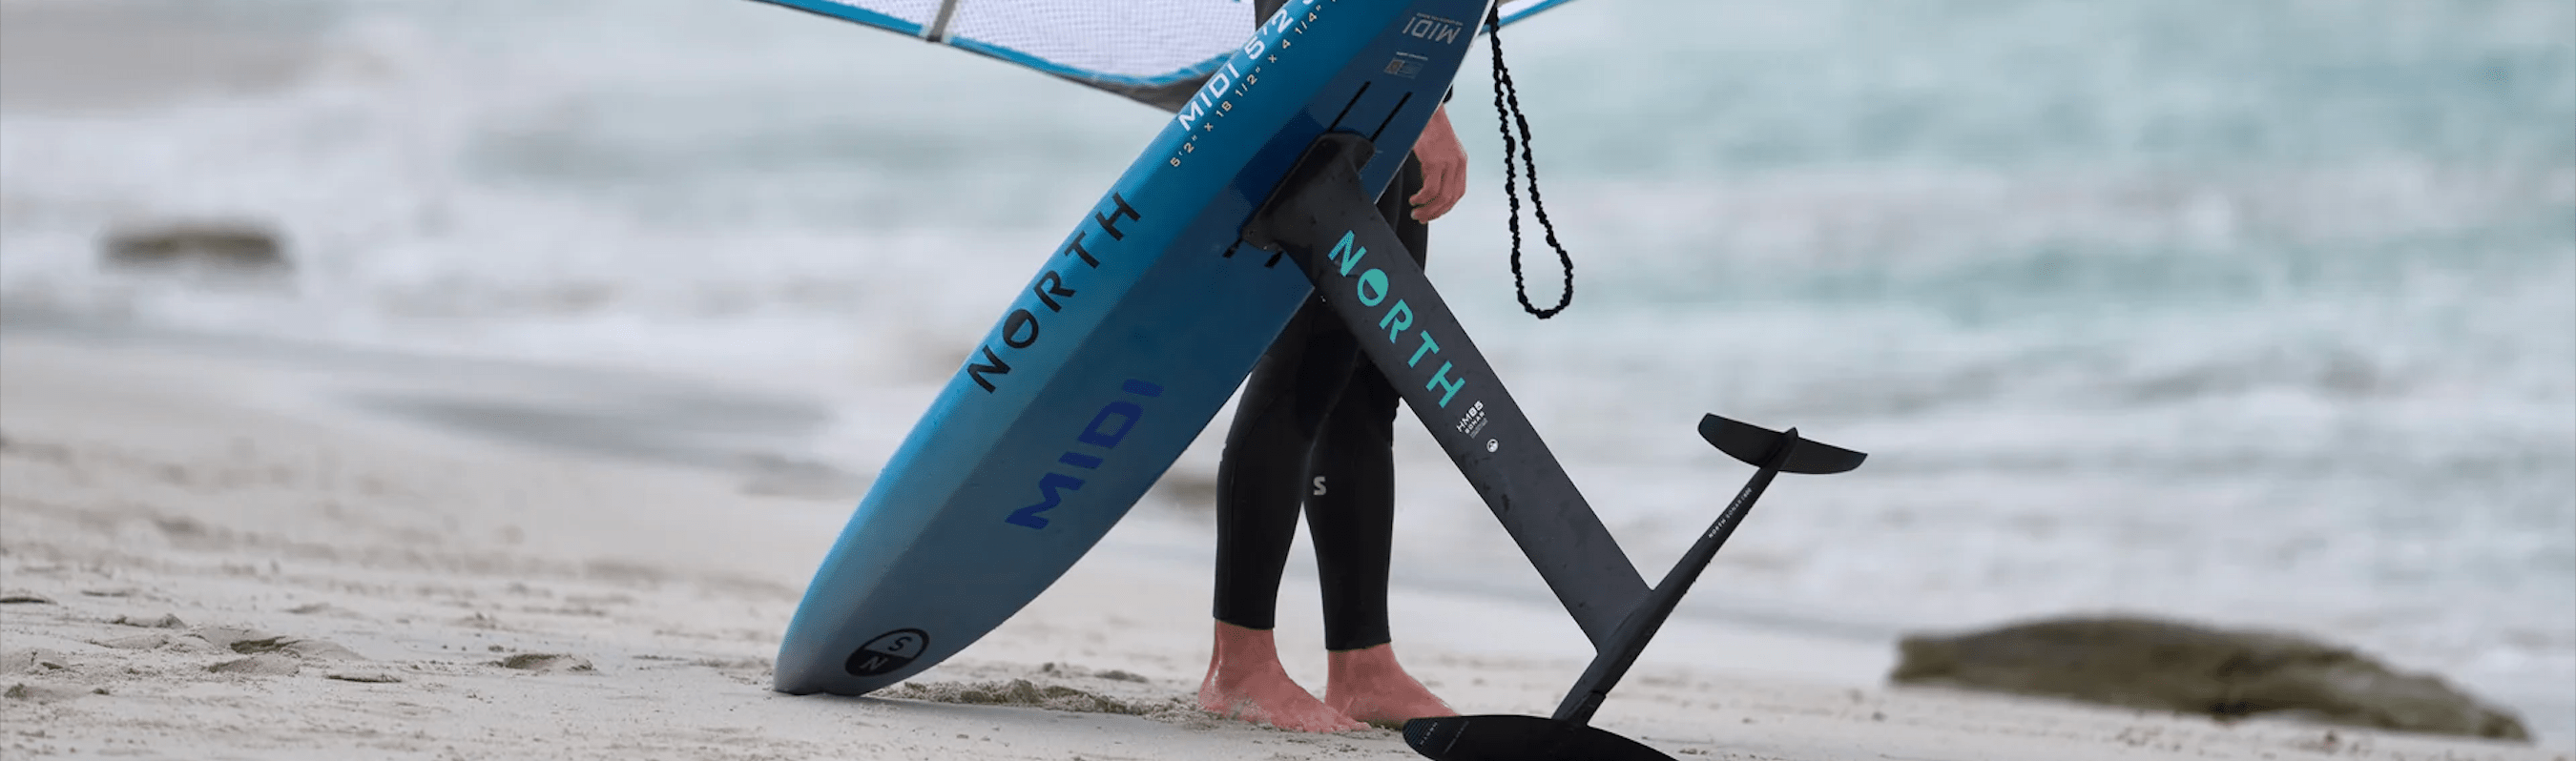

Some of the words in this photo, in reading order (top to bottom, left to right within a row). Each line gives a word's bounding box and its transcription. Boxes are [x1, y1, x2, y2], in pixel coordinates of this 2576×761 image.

[1402, 16, 1462, 45] MIDI
[1176, 63, 1240, 132] MIDI
[1216, 100, 1233, 119] 18
[1235, 67, 1261, 98] 1/2"
[1282, 38, 1291, 49] 4
[967, 192, 1141, 394] NORTH
[1327, 230, 1466, 408] NORTH
[1004, 378, 1164, 529] MIDI
[1313, 476, 1326, 496] S
